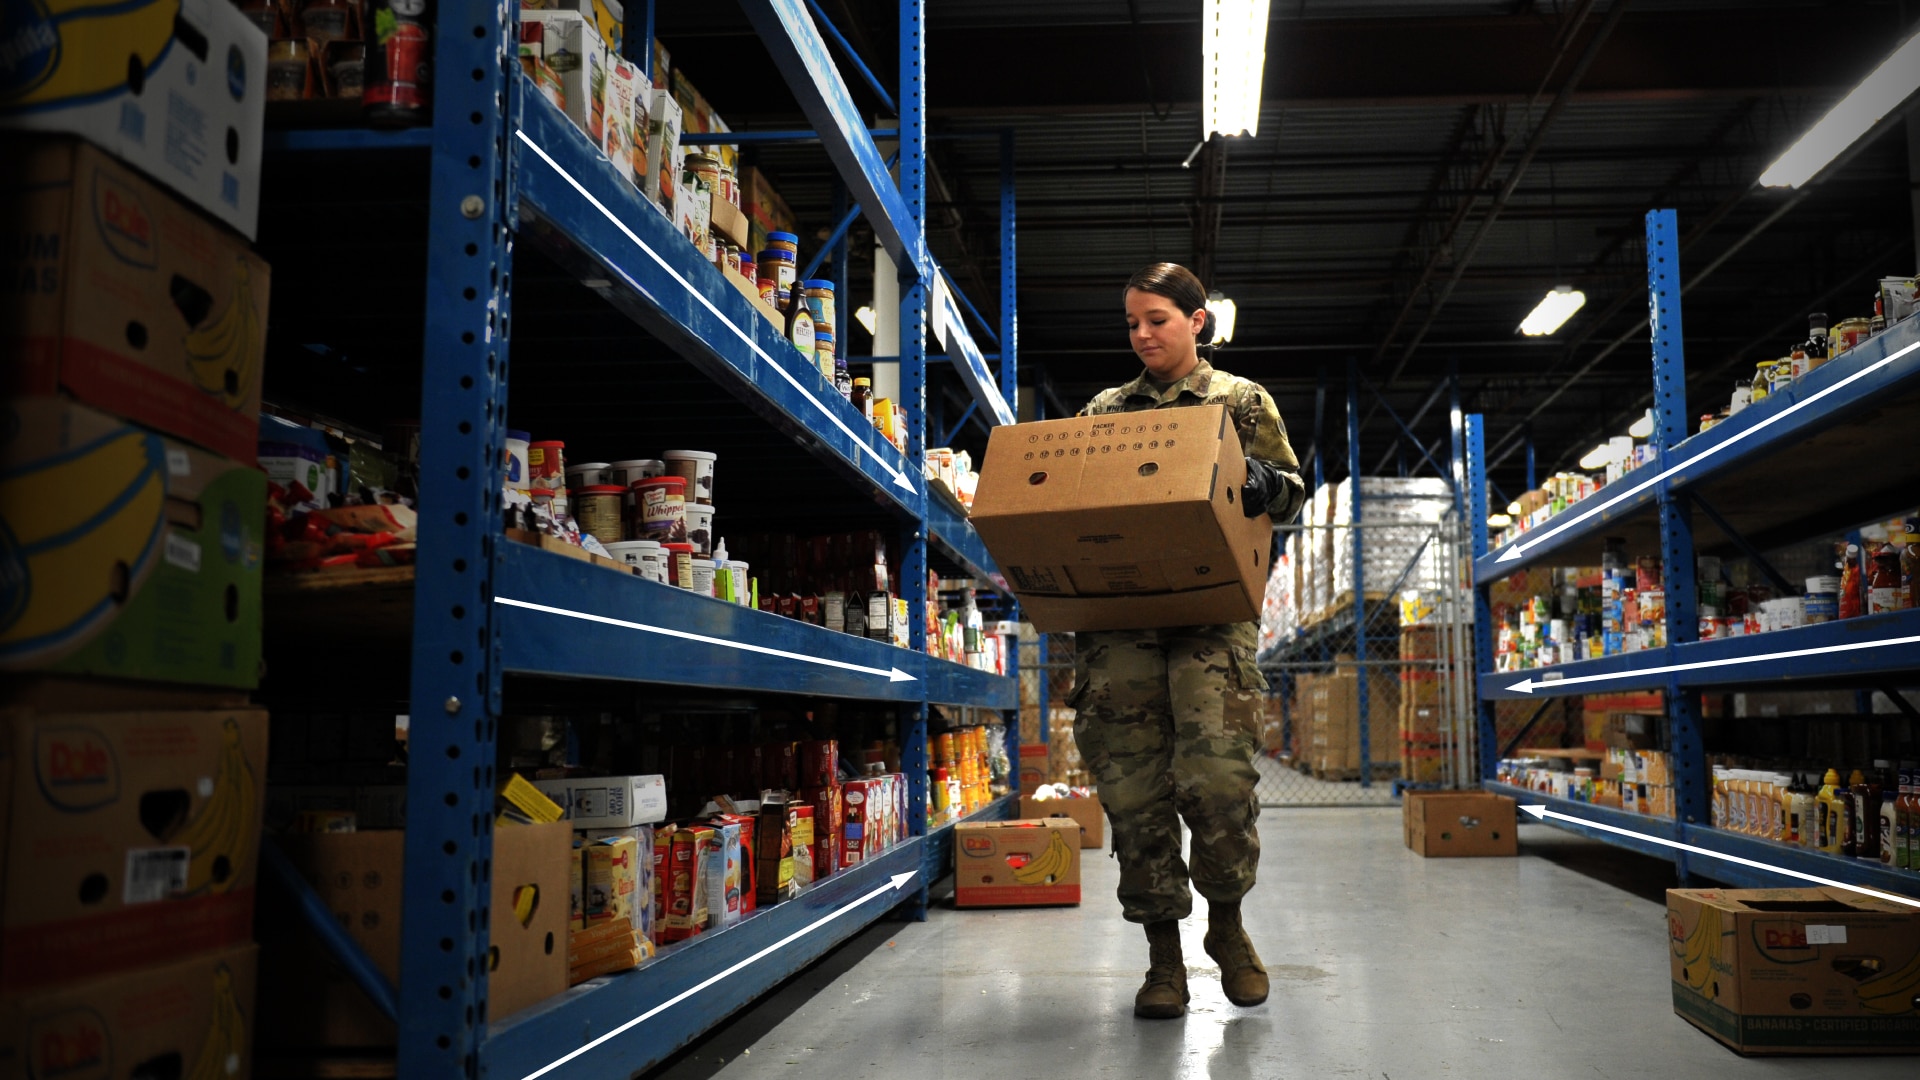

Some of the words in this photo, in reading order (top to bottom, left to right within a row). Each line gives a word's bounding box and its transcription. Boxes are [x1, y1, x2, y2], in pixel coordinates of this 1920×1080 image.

[103, 188, 149, 242] Dole
[1205, 395, 1229, 405] ARMY
[1106, 405, 1129, 413] WHITE
[1092, 422, 1115, 430] PACKER
[50, 741, 108, 777] Dole
[615, 787, 624, 816] SHOW
[966, 838, 991, 850] Dole
[1765, 929, 1807, 948] Dole
[1747, 1018, 1803, 1032] BANANAS
[1813, 1018, 1869, 1032] CERTIFIED
